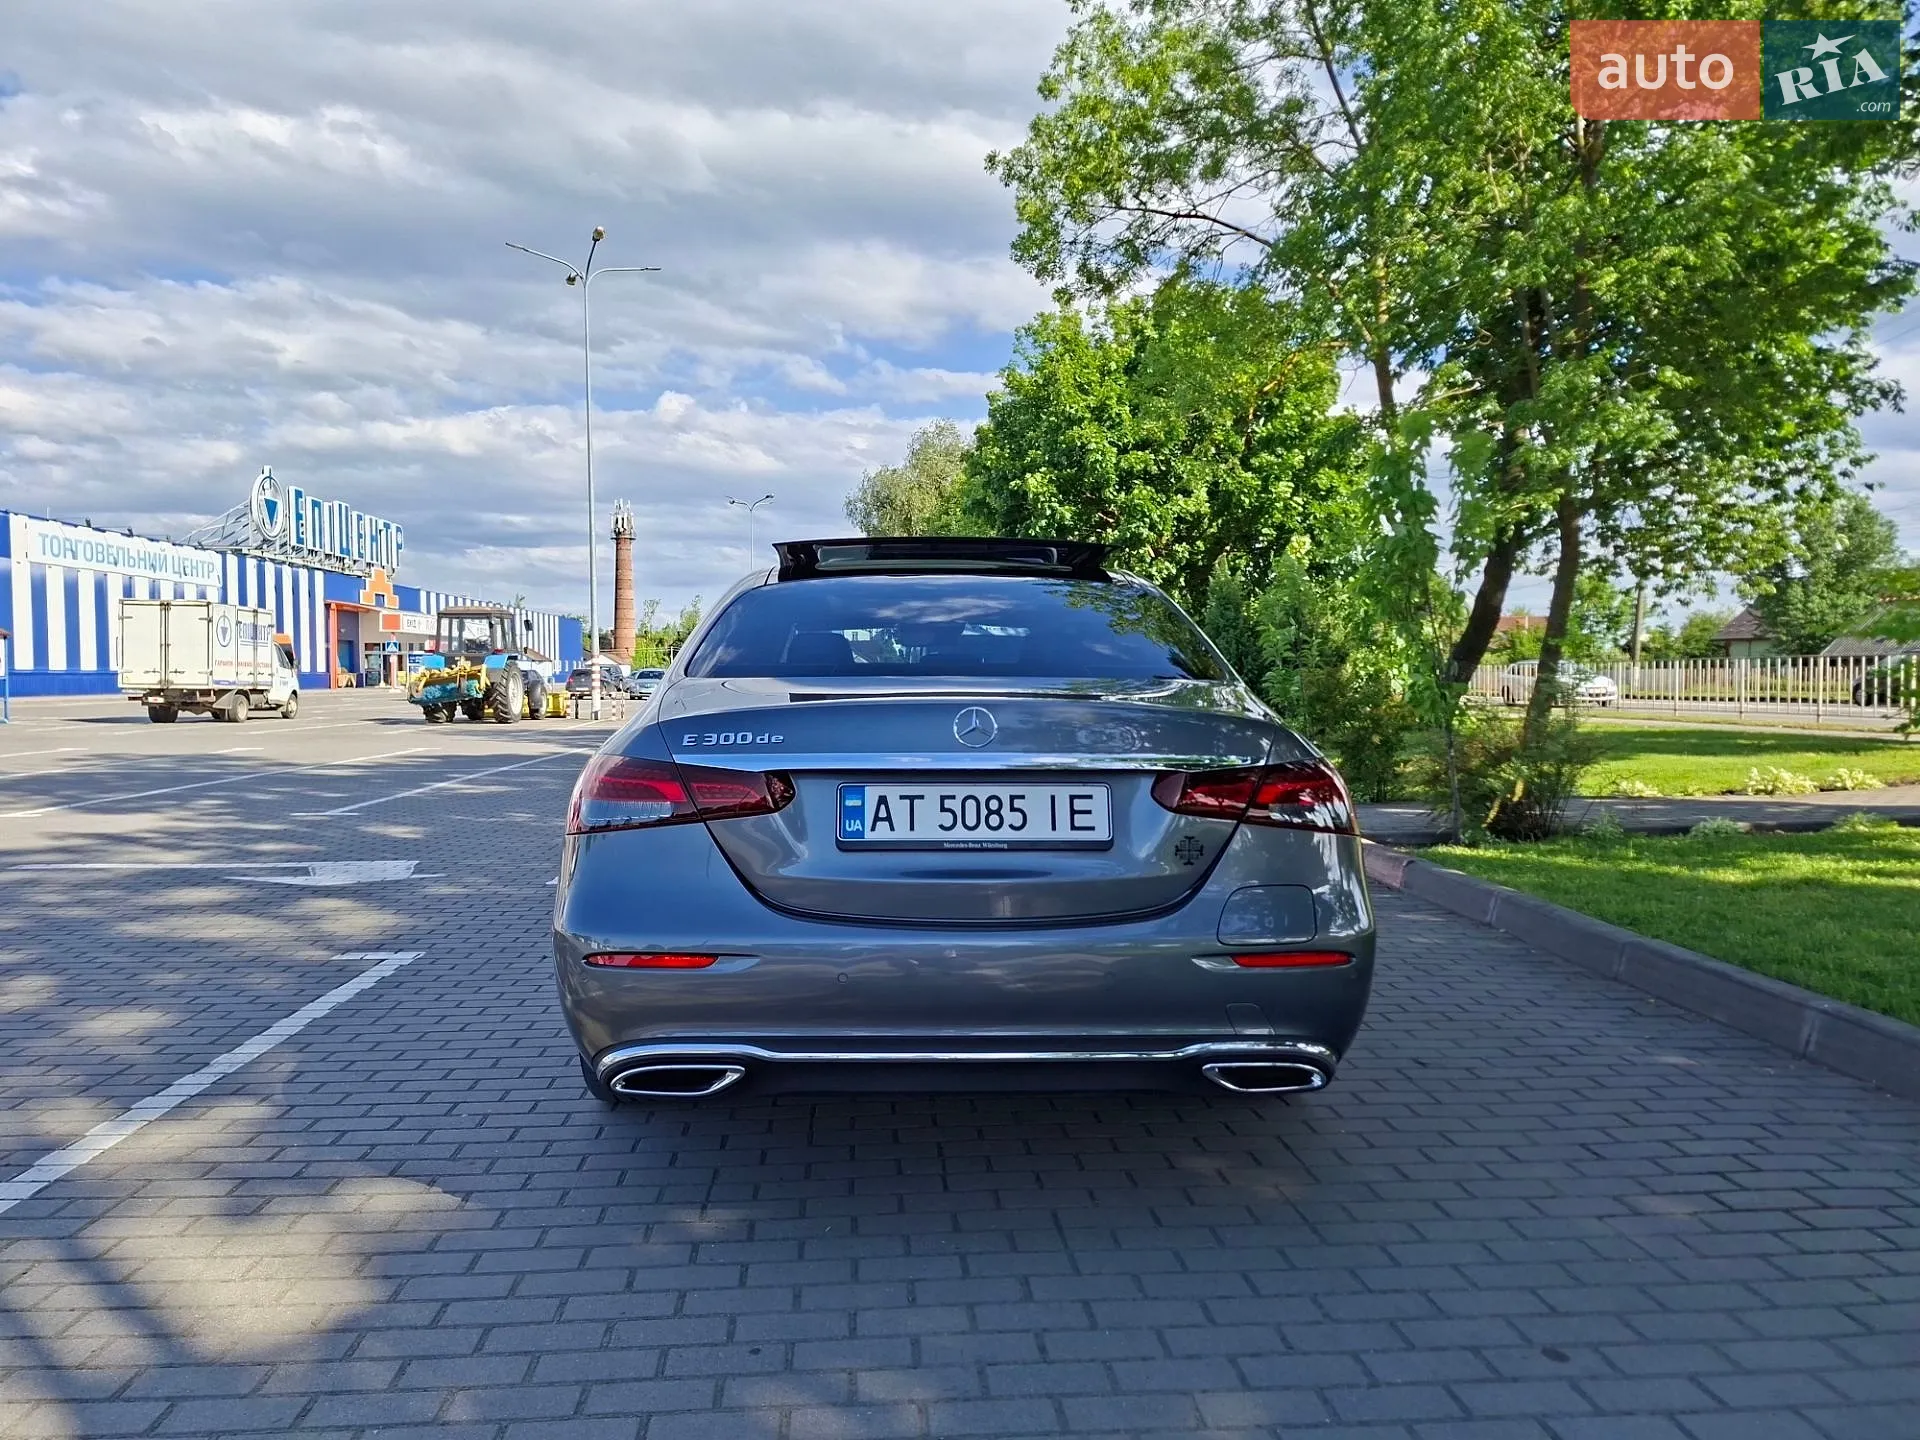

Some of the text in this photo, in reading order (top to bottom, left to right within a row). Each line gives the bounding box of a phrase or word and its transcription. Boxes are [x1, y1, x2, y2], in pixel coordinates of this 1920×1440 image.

[38, 533, 215, 579] ТОРГОВЕЛЬНИЙ ЦЕНТР
[682, 734, 699, 746] E
[845, 819, 863, 832] UA
[870, 795, 1096, 832] AT 5085 IE
